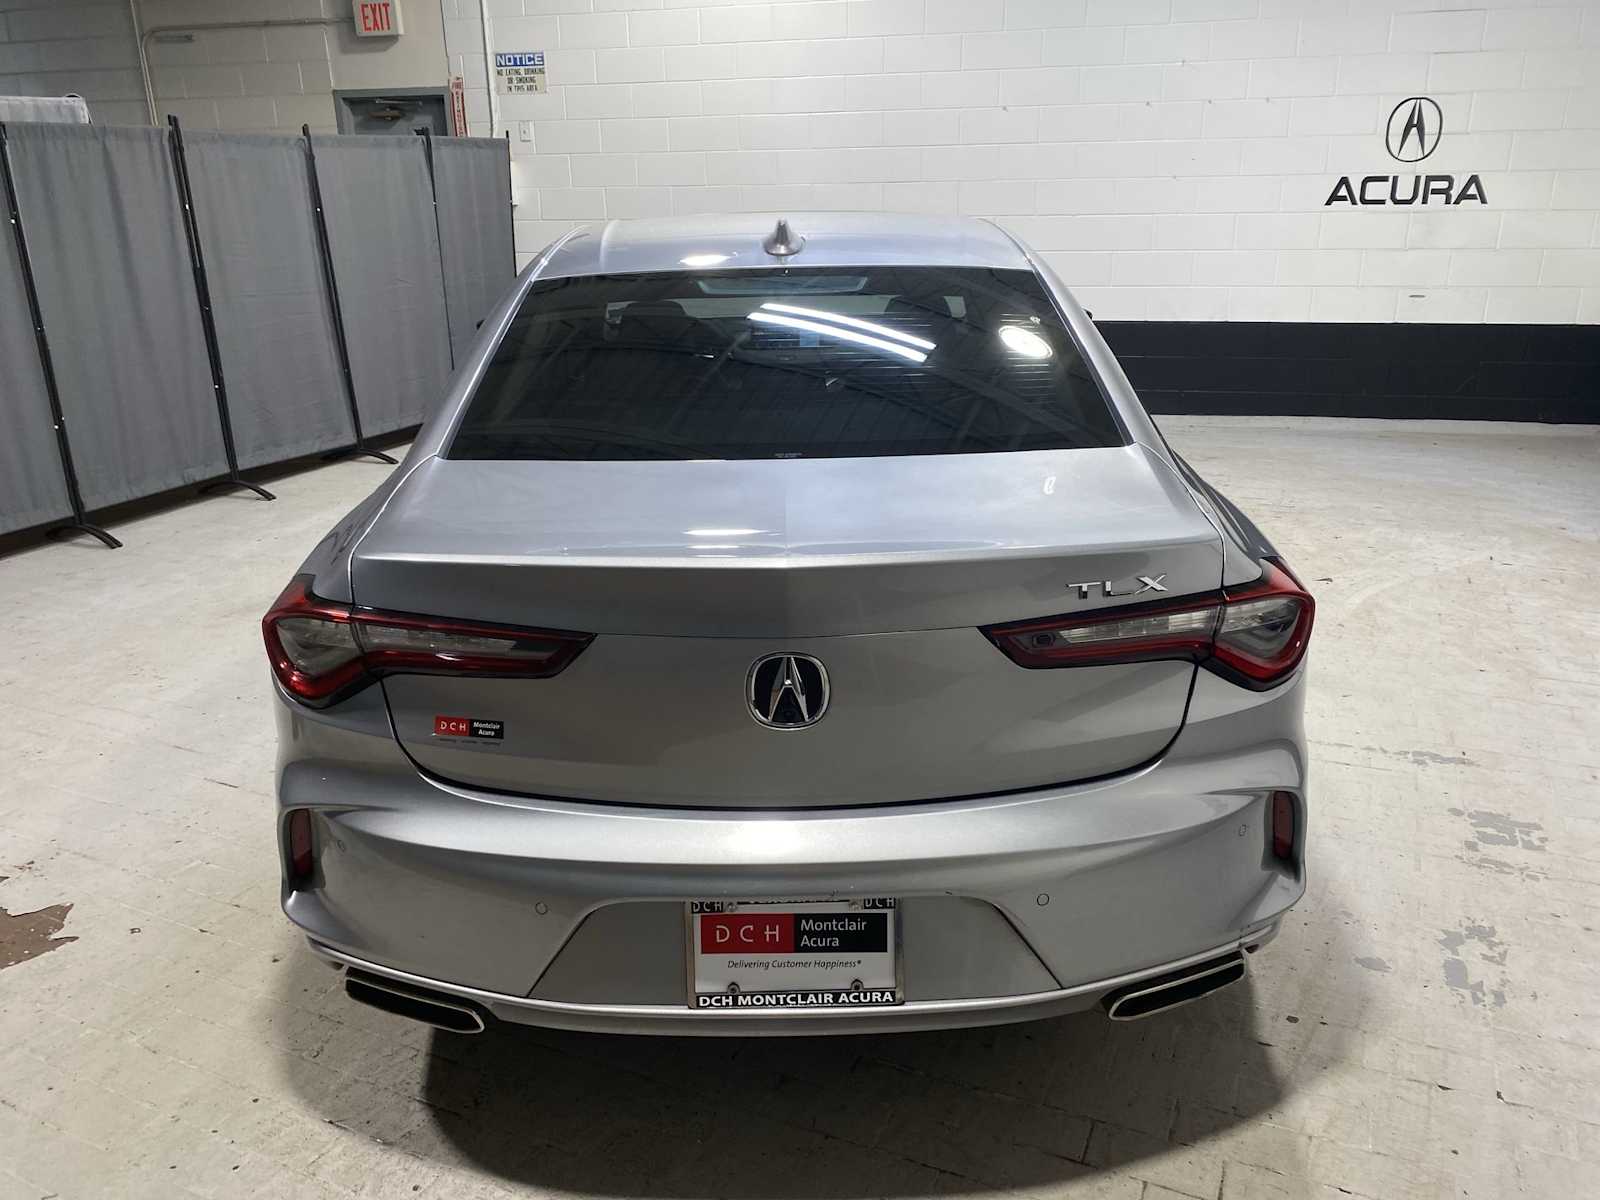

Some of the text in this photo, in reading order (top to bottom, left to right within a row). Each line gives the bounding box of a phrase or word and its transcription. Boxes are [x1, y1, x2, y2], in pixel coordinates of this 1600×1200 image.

[361, 3, 391, 31] EXIT
[496, 54, 544, 66] NOTICE
[1324, 174, 1488, 206] ACURA
[1066, 574, 1169, 600] TLX
[473, 721, 501, 730] Montclair
[800, 918, 867, 932] Montclair
[800, 935, 840, 948] Acura
[727, 960, 770, 971] Delivering
[771, 960, 812, 968] Customer
[699, 991, 894, 1007] DCH MONTCLAIR ACURA
